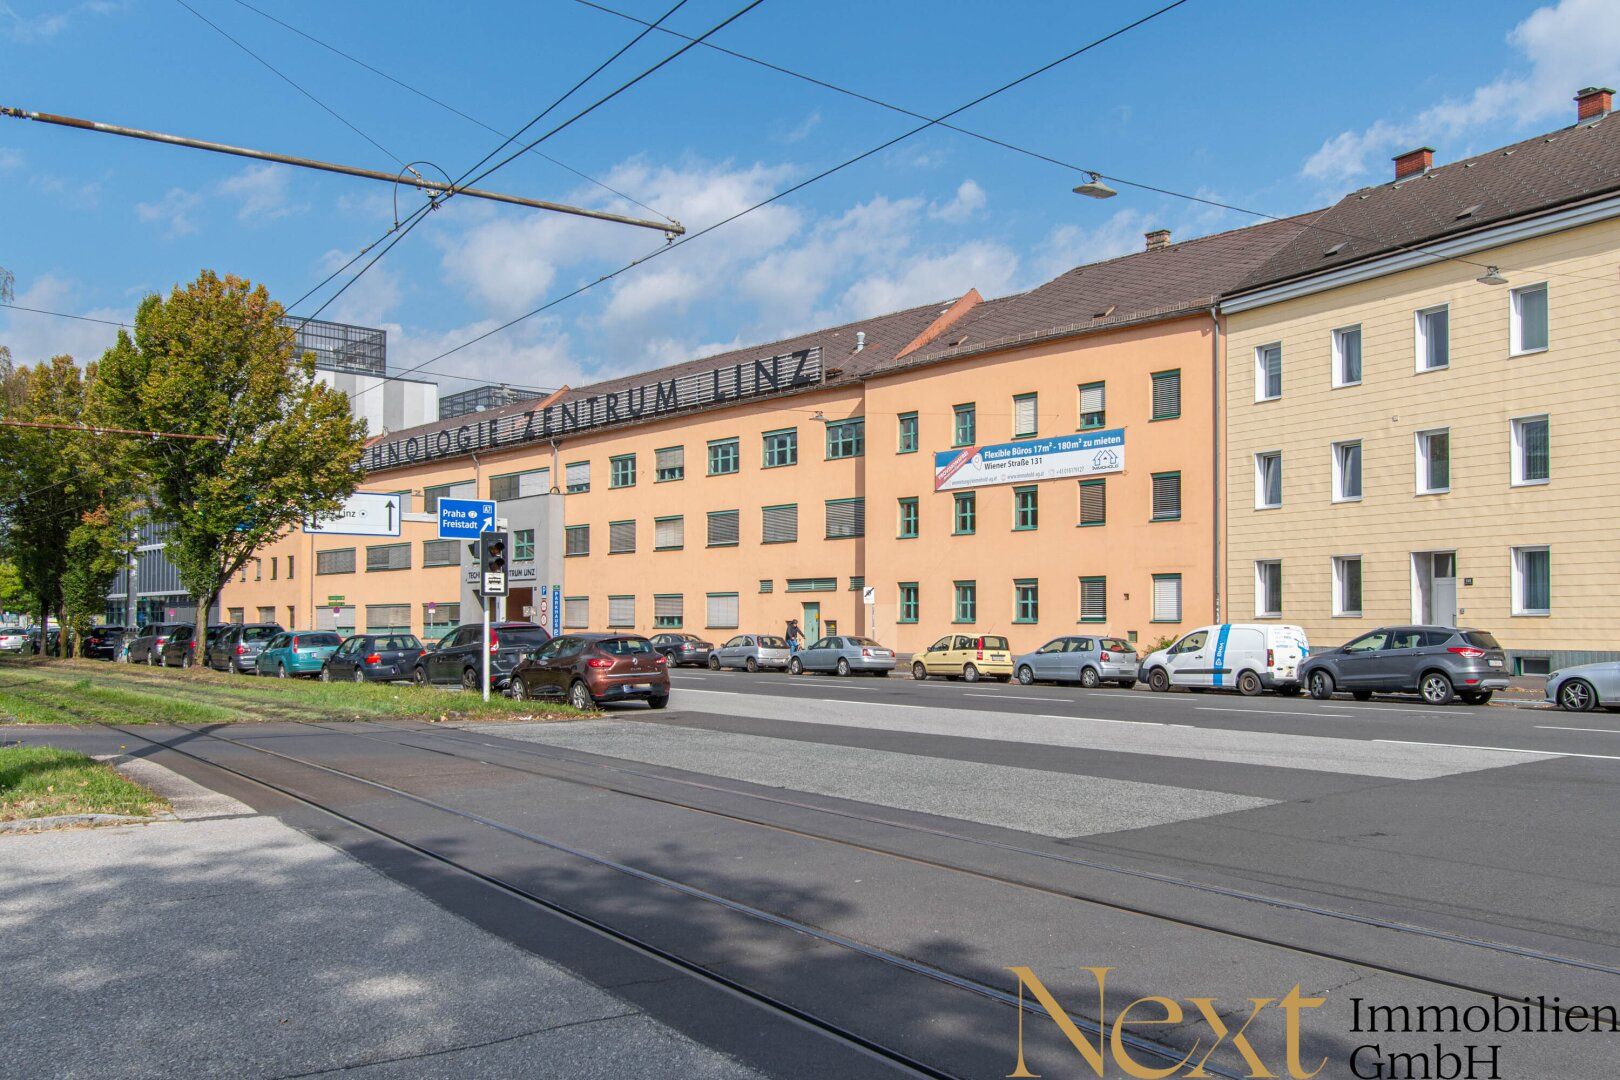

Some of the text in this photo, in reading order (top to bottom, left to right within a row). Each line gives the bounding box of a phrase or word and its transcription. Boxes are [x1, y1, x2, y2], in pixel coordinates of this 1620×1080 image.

[372, 349, 811, 470] HNOLOGIE ZENTRUM LINZ
[984, 448, 1011, 460] Flexible
[1012, 446, 1032, 457] Büros
[1083, 440, 1093, 448] zu
[1093, 436, 1121, 446] mieten
[984, 457, 1043, 470] Wiener Straße 131
[339, 508, 356, 518] Linz
[443, 508, 466, 518] Praha
[443, 519, 478, 529] Freistadt
